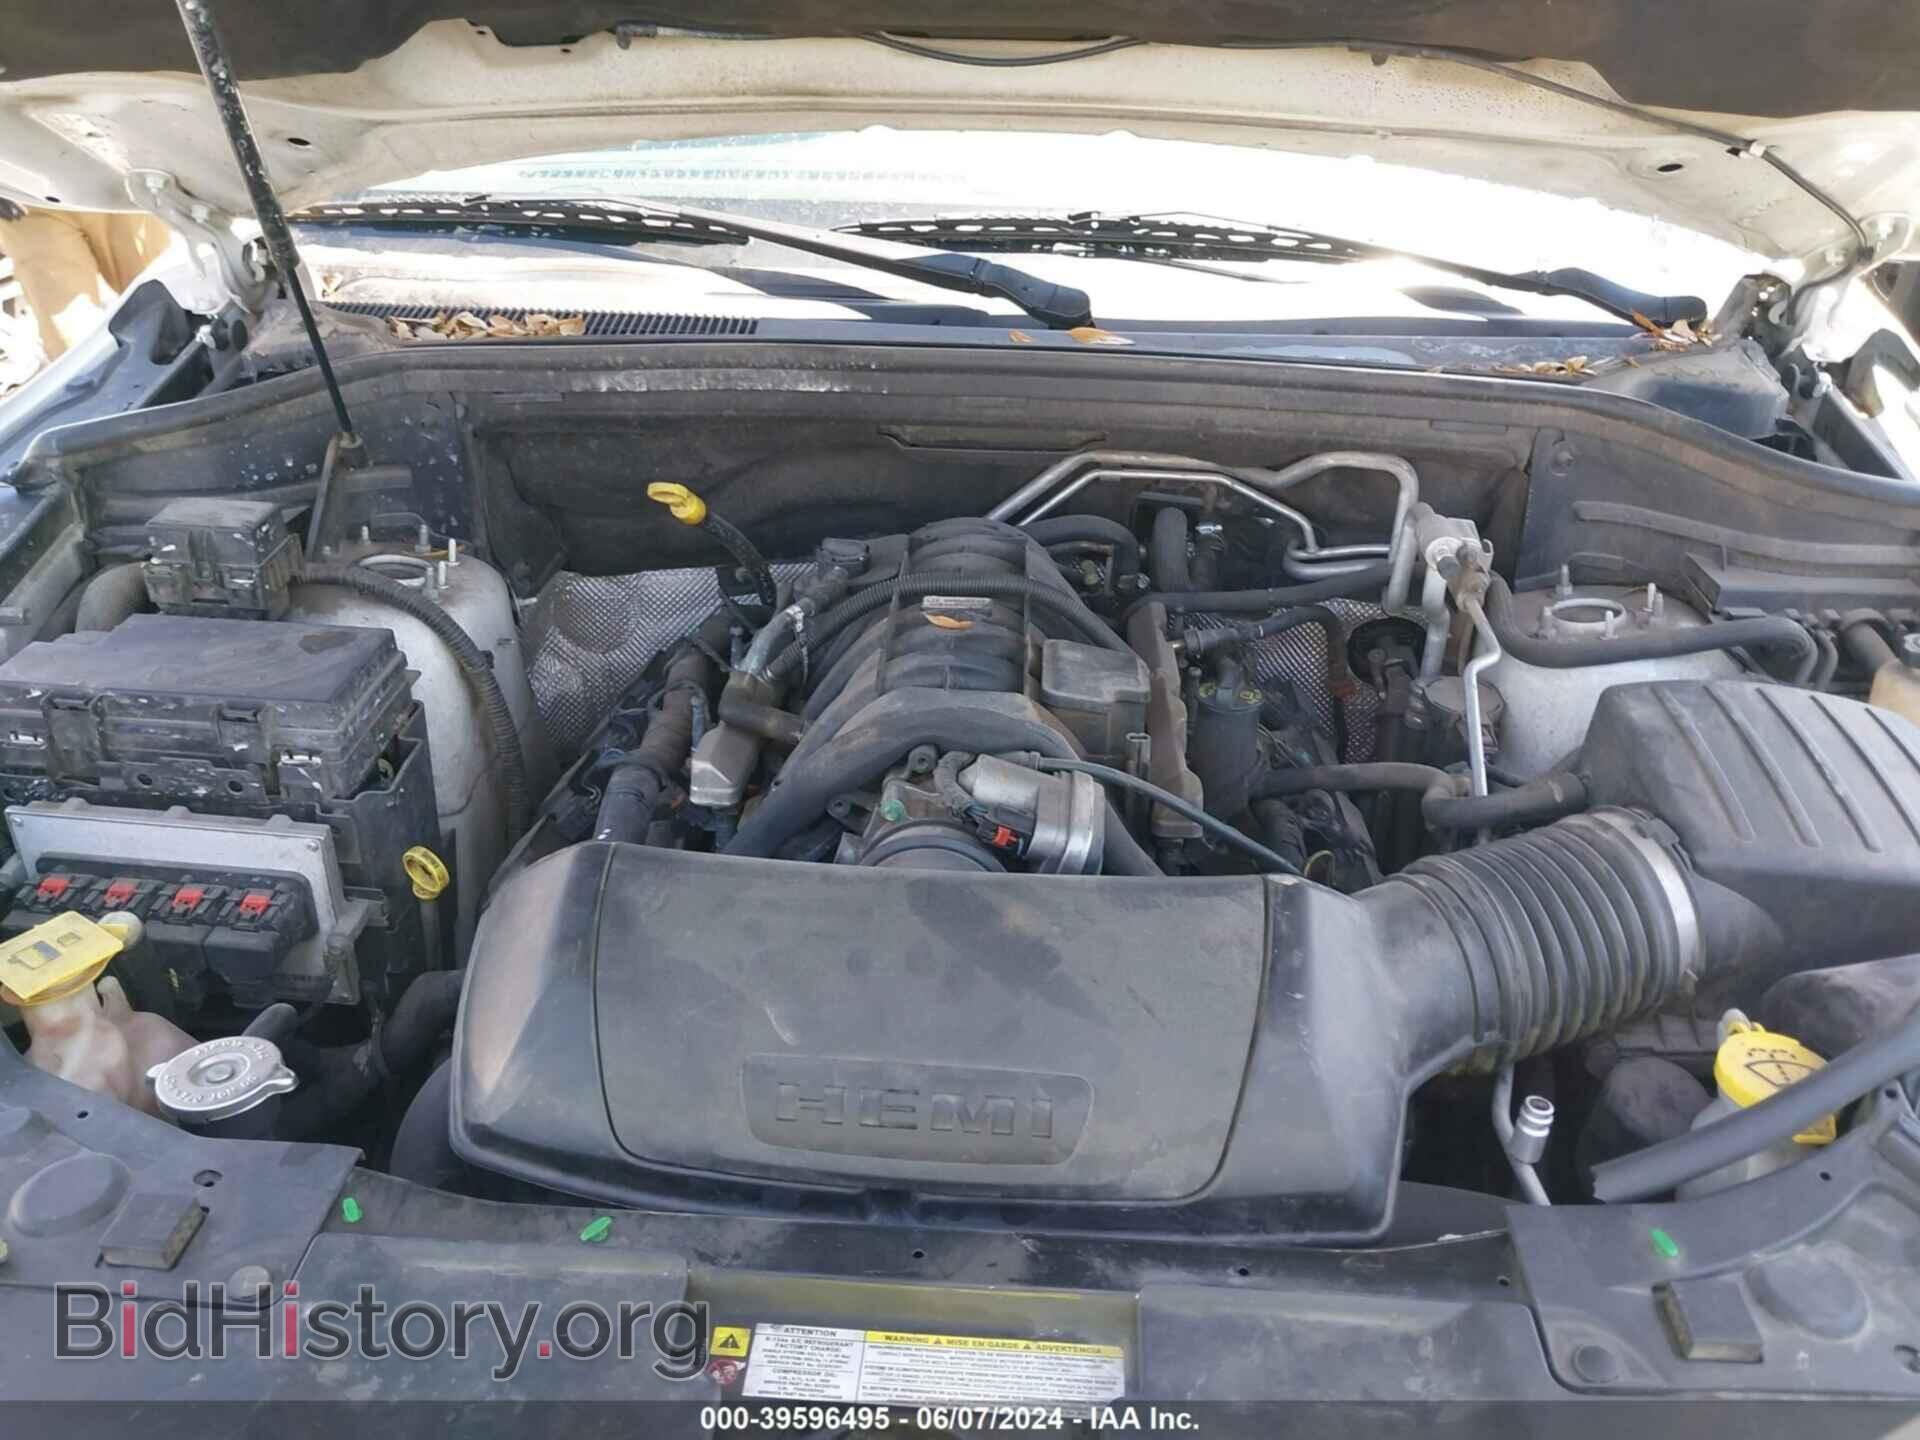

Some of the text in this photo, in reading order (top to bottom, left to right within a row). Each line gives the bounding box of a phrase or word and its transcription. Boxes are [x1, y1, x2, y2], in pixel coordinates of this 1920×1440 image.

[776, 1082, 1052, 1139] HEMI
[784, 1328, 837, 1337] ATTENTION
[885, 1335, 929, 1344] WARNING
[947, 1339, 969, 1347] MISE
[971, 1340, 984, 1348] EN
[986, 1341, 1020, 1350] GARDE
[1037, 1344, 1102, 1355] ADVERTENCIA
